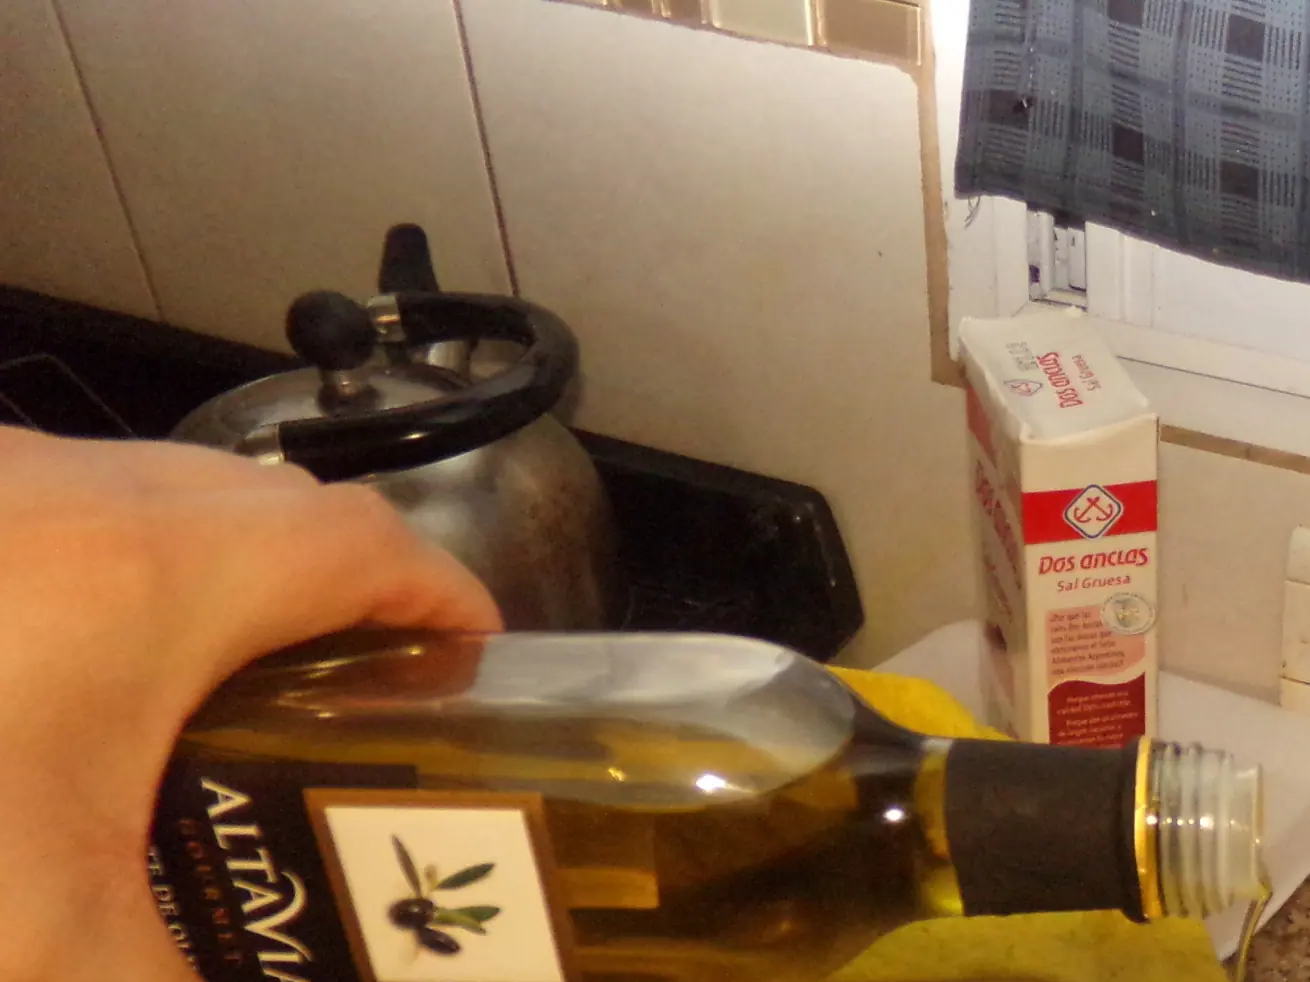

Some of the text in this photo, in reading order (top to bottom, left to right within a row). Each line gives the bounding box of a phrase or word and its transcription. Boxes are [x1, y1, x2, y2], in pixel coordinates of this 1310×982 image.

[1056, 387, 1083, 408] Dos
[1038, 555, 1075, 575] Dos
[1057, 575, 1131, 592] Sal Gruesa
